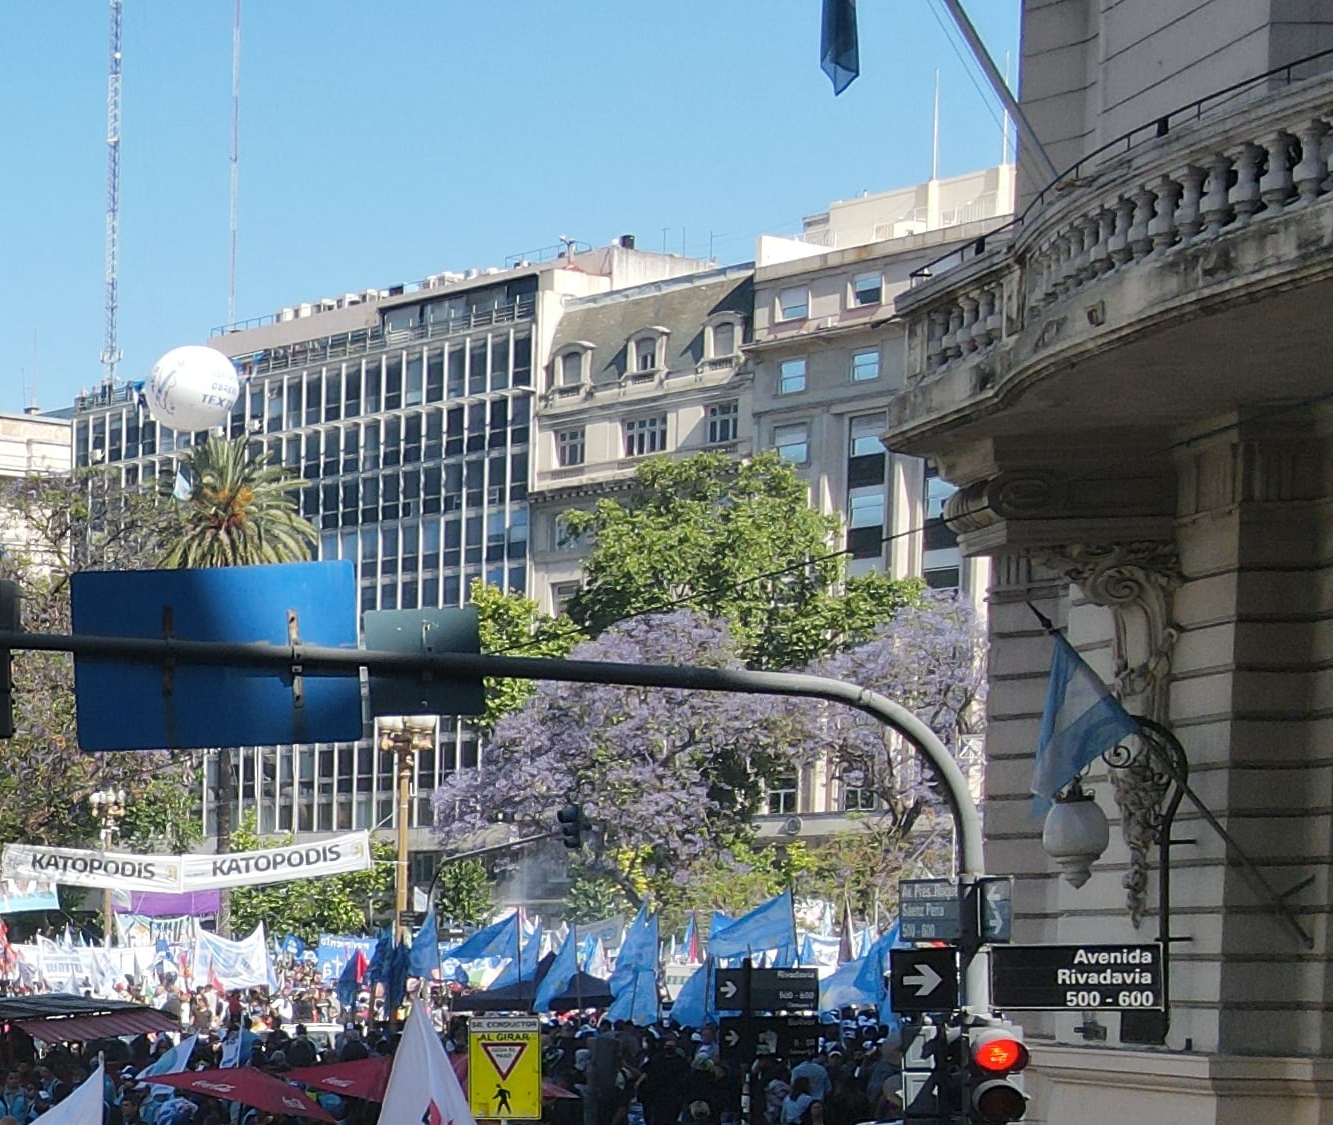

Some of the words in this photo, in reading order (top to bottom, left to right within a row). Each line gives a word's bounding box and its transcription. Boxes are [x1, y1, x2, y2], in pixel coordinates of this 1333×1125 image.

[32, 853, 156, 880] KATOPODIS
[212, 843, 341, 877] KATOPODIS
[1074, 949, 1152, 965] Avenida
[1057, 969, 1152, 985] Rivadavia
[1066, 991, 1099, 1007] 500
[1118, 991, 1154, 1007] 600
[478, 1033, 493, 1041] AL
[496, 1033, 532, 1041] GIRAR
